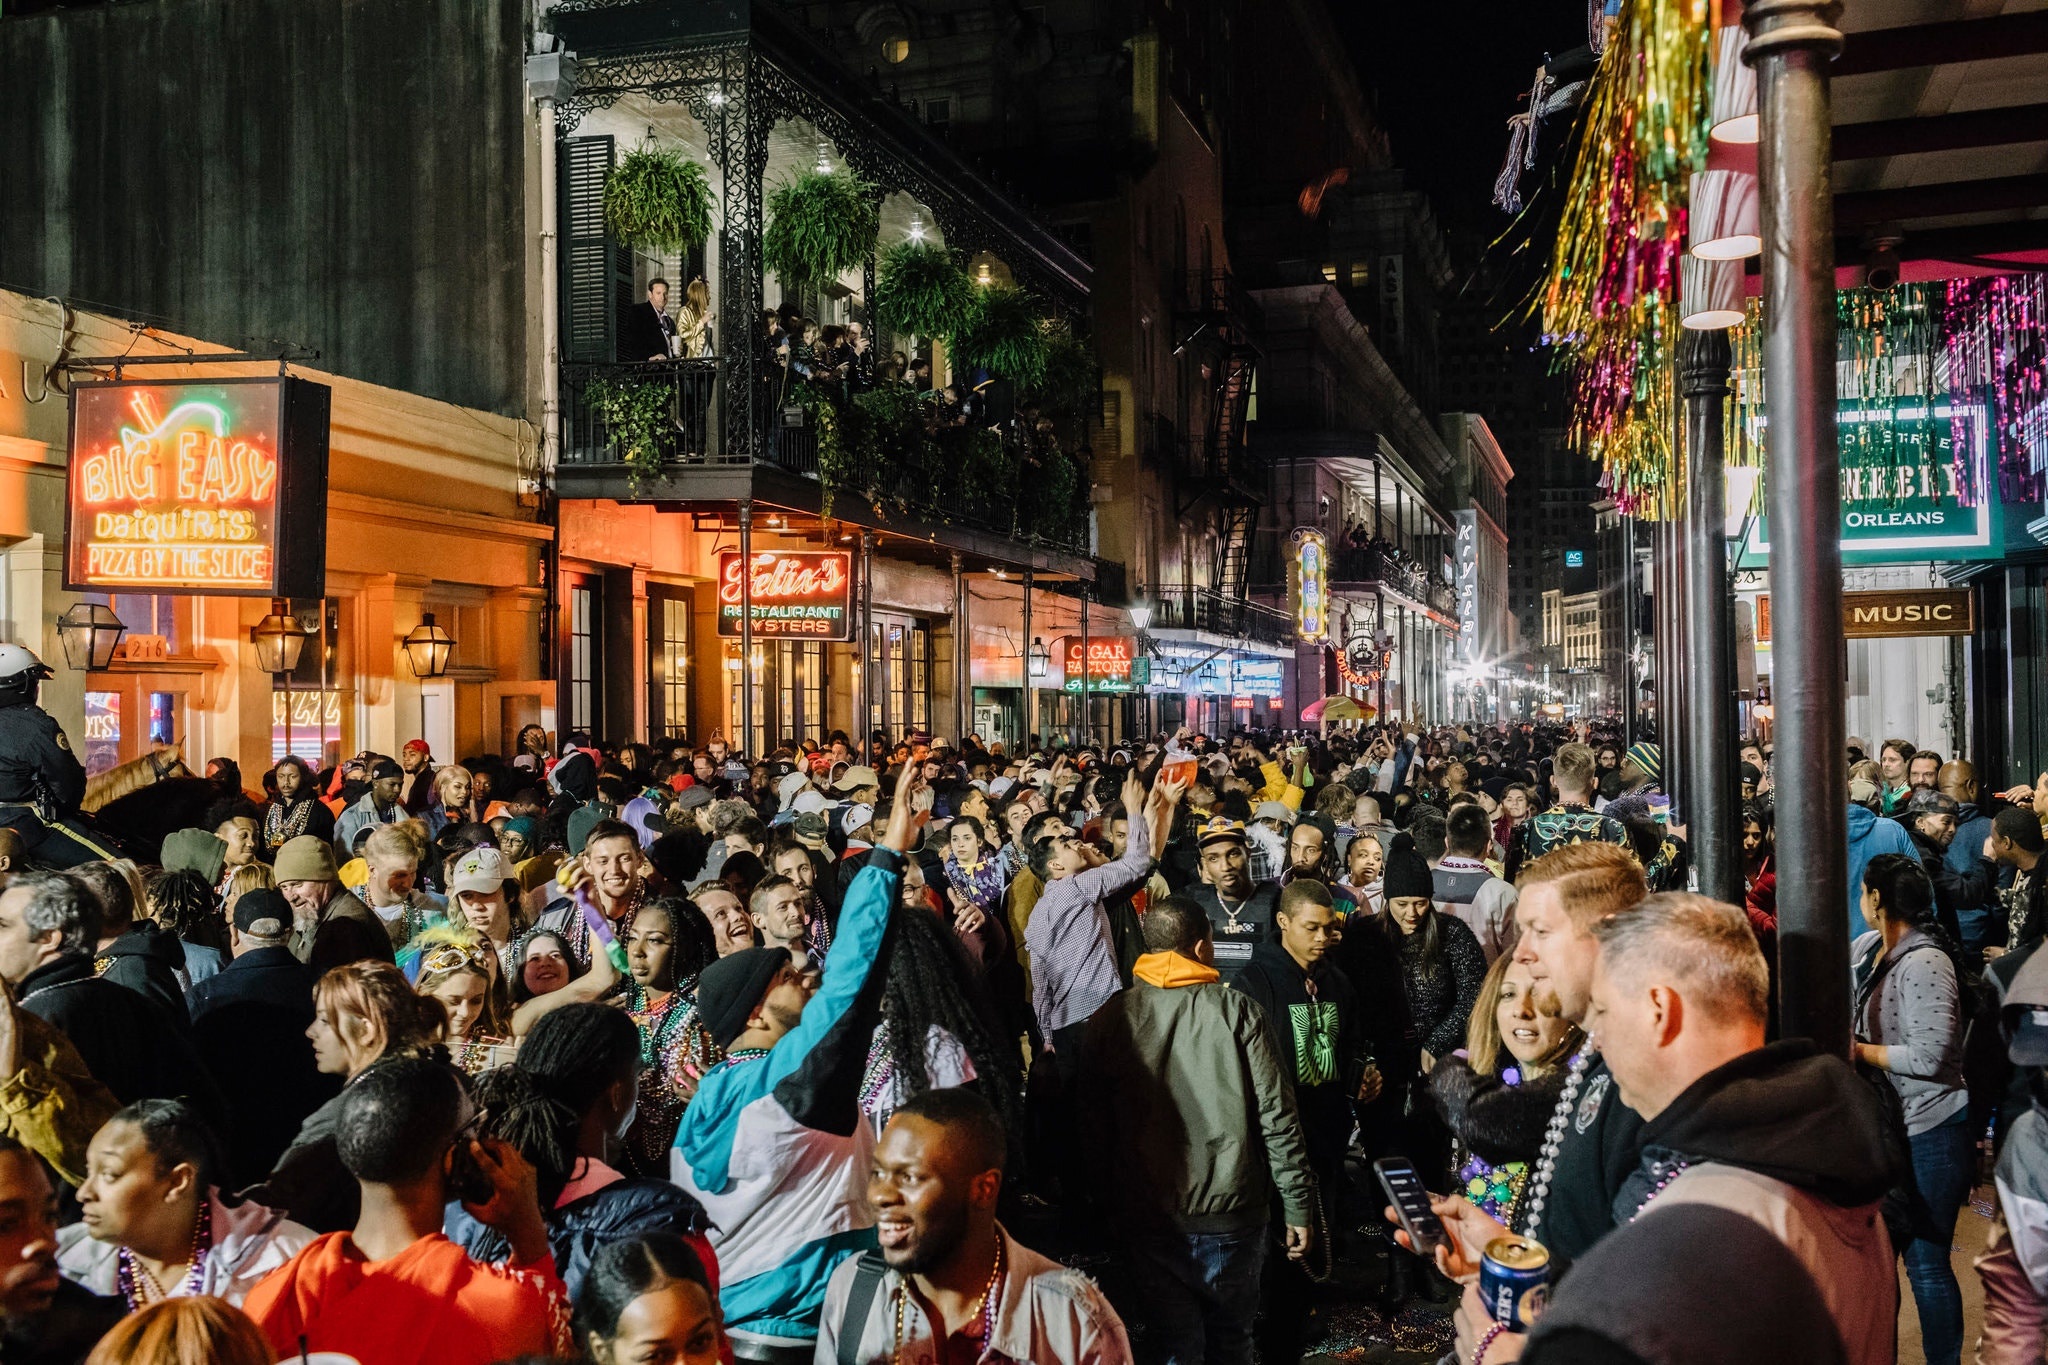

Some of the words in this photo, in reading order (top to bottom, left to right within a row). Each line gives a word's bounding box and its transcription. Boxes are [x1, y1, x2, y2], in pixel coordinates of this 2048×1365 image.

[83, 441, 156, 502] BIG
[177, 431, 276, 502] EASY
[1845, 511, 1945, 528] ORLEANS
[89, 549, 136, 577] PIZZA
[142, 548, 166, 577] BY
[172, 547, 207, 577] THE
[210, 547, 266, 579] SLICE
[1568, 552, 1581, 560] AC
[721, 553, 847, 603] Felix's
[1458, 524, 1475, 653] Krystal
[724, 604, 843, 620] RESTAURANT
[1853, 604, 1953, 623] MUSIC
[734, 620, 830, 633] OYSTERS
[1071, 645, 1126, 659] CGAR
[1066, 660, 1131, 673] FACTORY
[1336, 650, 1370, 685] BOURBON
[1065, 679, 1095, 691] Nw
